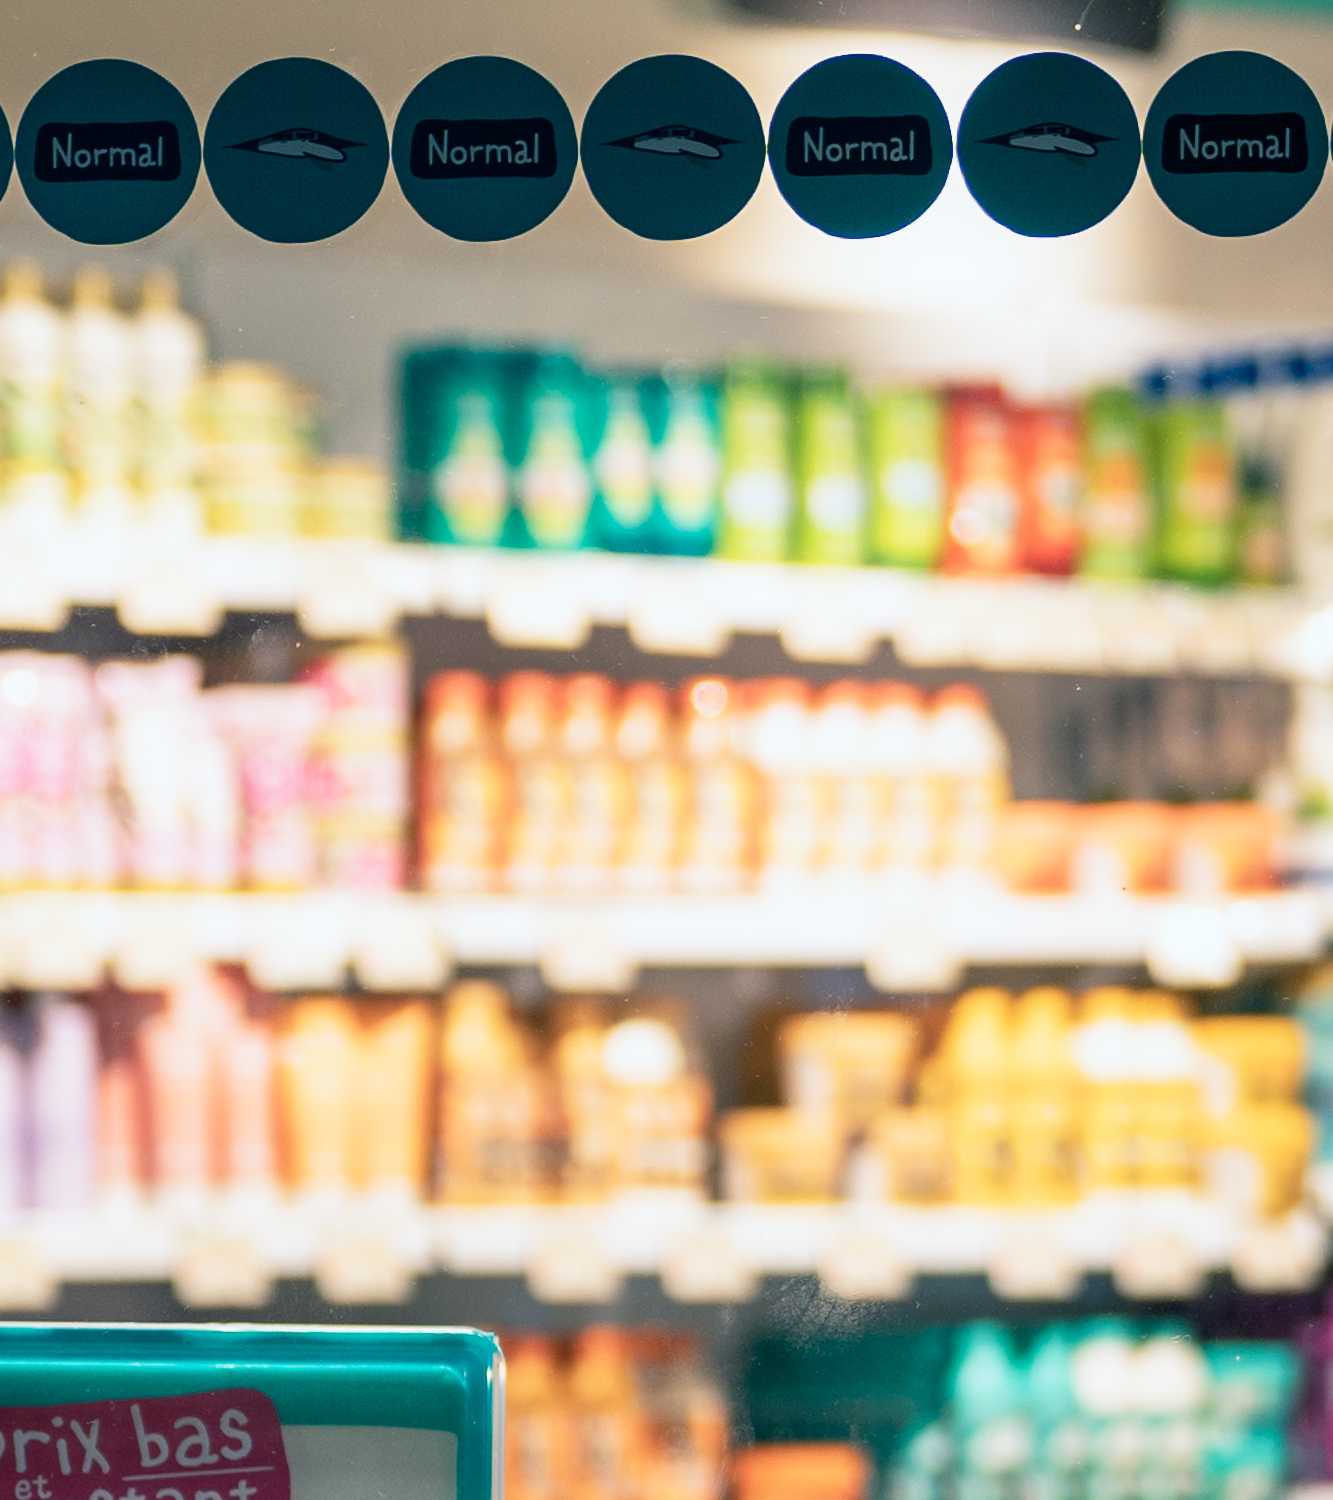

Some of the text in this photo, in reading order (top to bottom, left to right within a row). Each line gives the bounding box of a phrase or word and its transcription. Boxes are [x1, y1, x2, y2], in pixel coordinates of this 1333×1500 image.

[52, 132, 163, 169] Normal
[428, 129, 539, 166] Normal
[803, 126, 915, 163] Normal
[1179, 124, 1290, 160] Normal
[0, 1403, 252, 1476] rix bas
